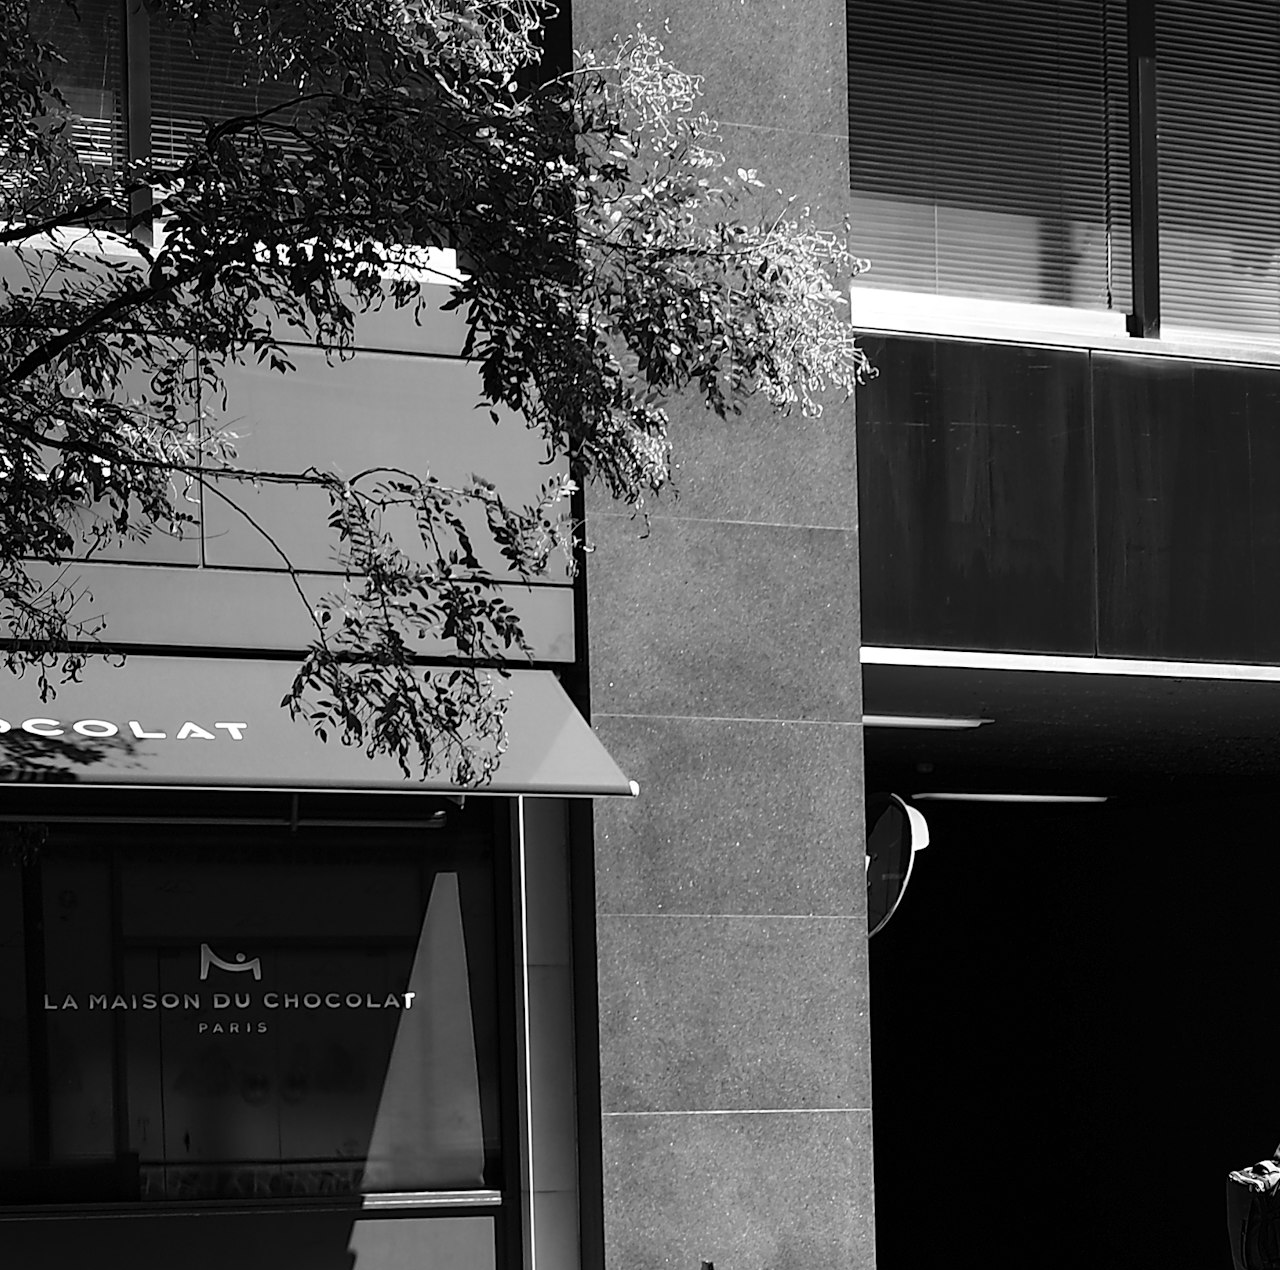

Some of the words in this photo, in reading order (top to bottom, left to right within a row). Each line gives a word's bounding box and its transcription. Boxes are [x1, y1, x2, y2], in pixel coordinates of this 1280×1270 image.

[0, 718, 248, 741] COLAT
[43, 993, 79, 1010] LA
[89, 993, 201, 1010] MAISON
[213, 992, 251, 1009] DU
[263, 991, 416, 1010] CHOCOLAT
[198, 1022, 268, 1034] PARIS
